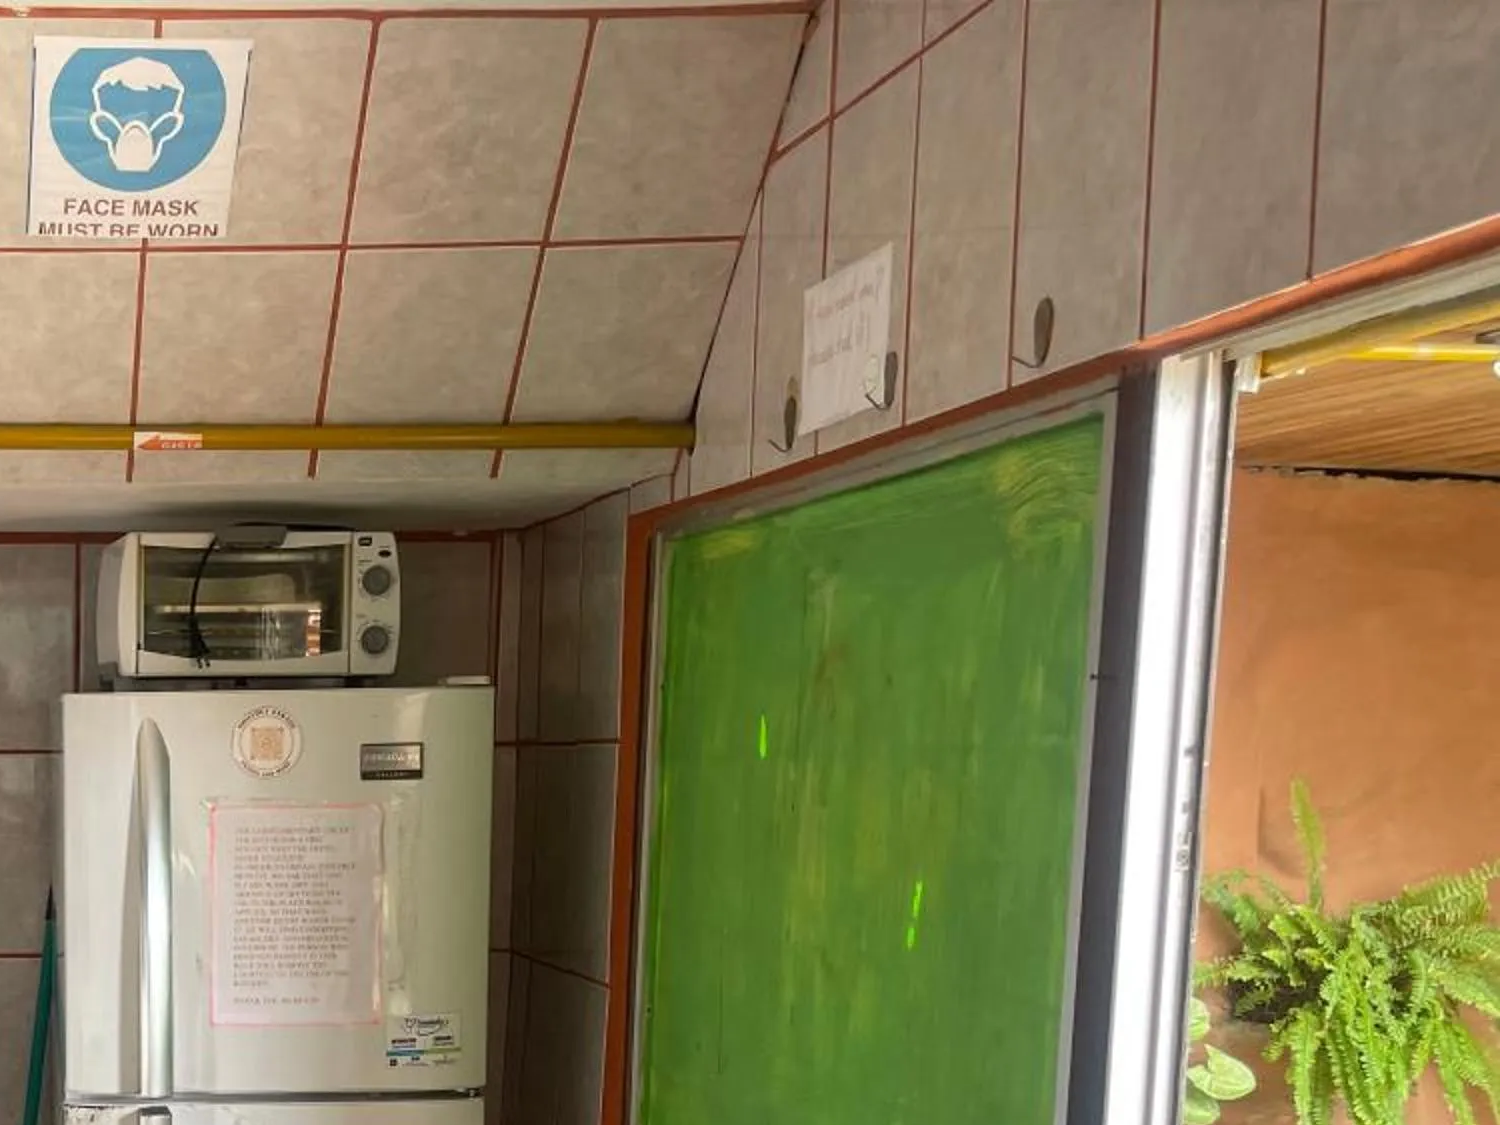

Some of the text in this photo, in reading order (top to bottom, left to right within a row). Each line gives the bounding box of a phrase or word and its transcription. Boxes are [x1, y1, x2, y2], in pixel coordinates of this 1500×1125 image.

[63, 199, 199, 217] FACE MASK
[39, 222, 218, 237] MUST BE WORN
